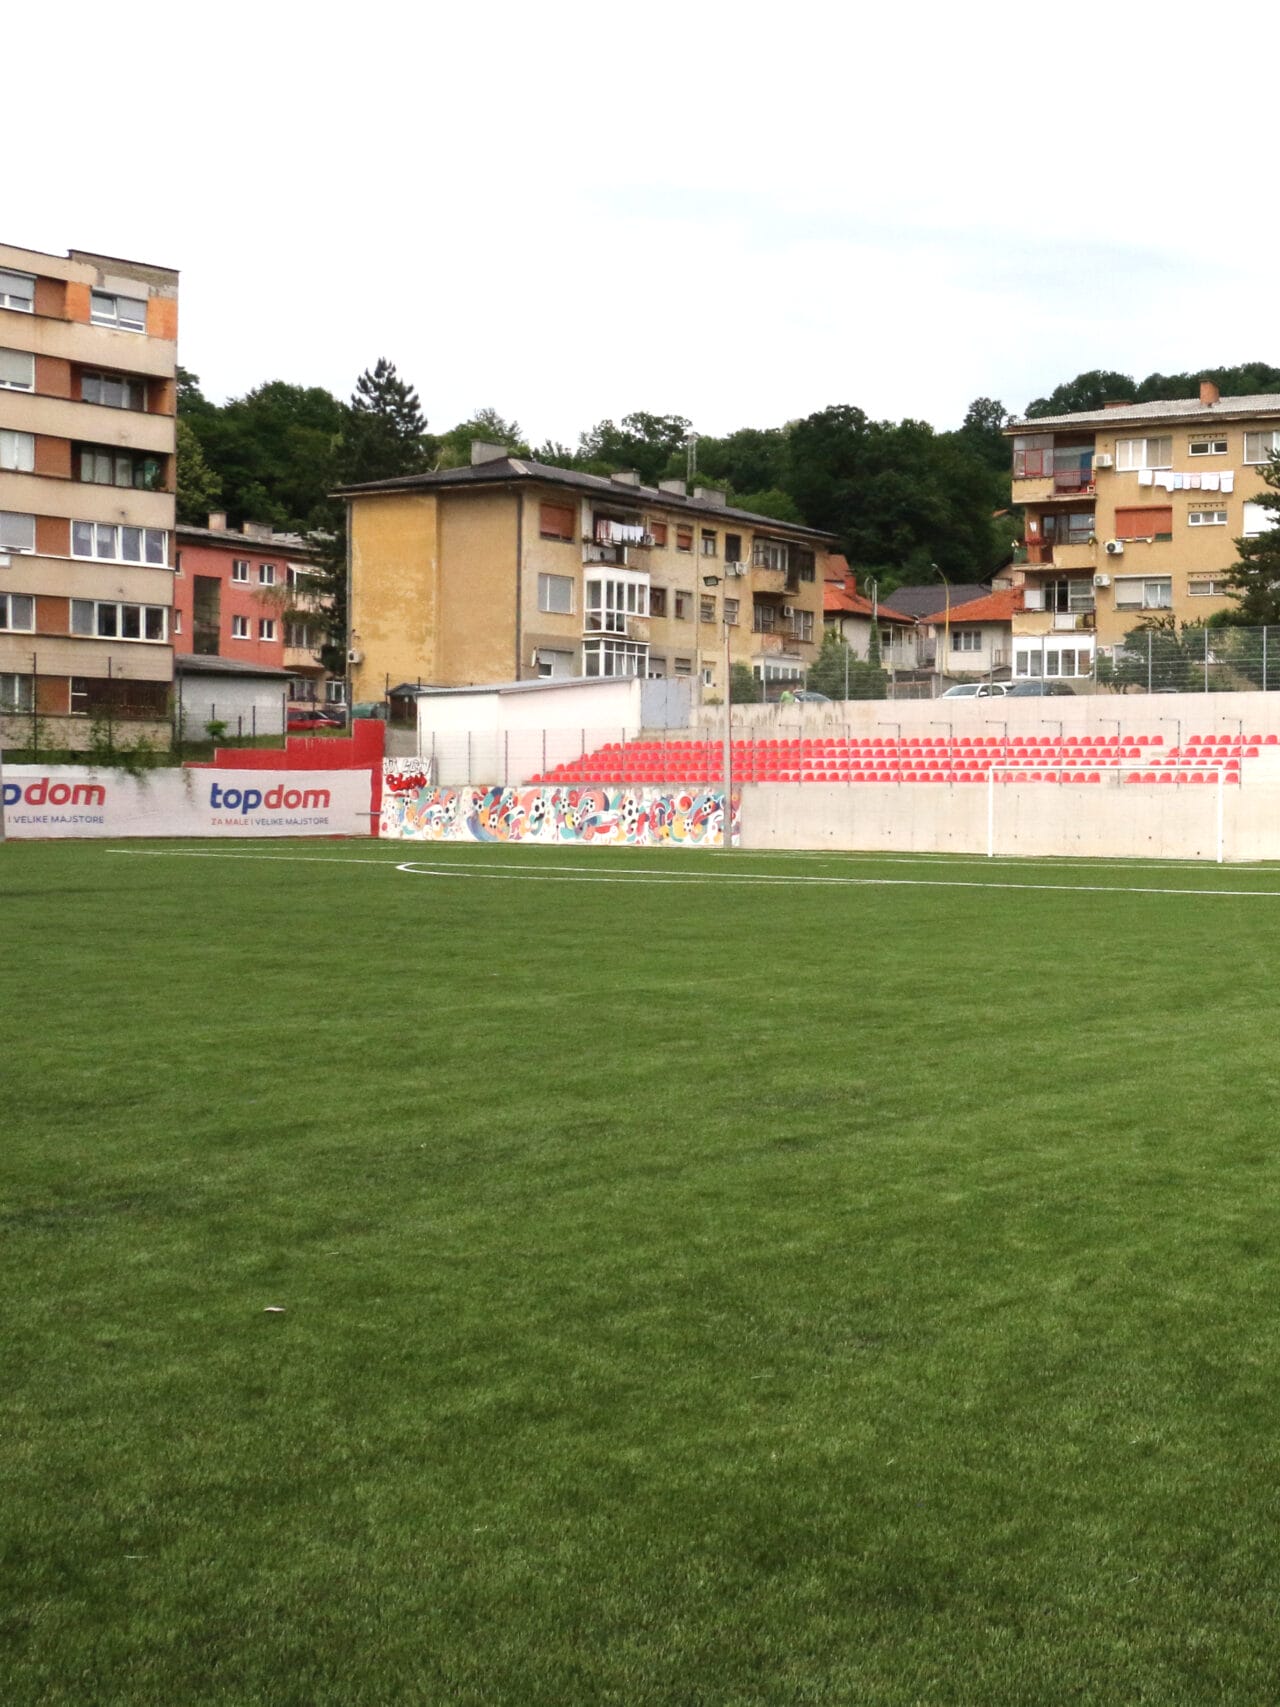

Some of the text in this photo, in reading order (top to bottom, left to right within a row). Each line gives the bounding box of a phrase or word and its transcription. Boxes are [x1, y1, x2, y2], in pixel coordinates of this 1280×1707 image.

[210, 782, 331, 815] topdom
[13, 815, 49, 824] VELIKE
[50, 815, 104, 824] MAJSTORE
[211, 818, 223, 826] ZA
[225, 818, 249, 826] MALE
[255, 818, 283, 826] VELIKE
[285, 816, 329, 825] MAJSTORE
